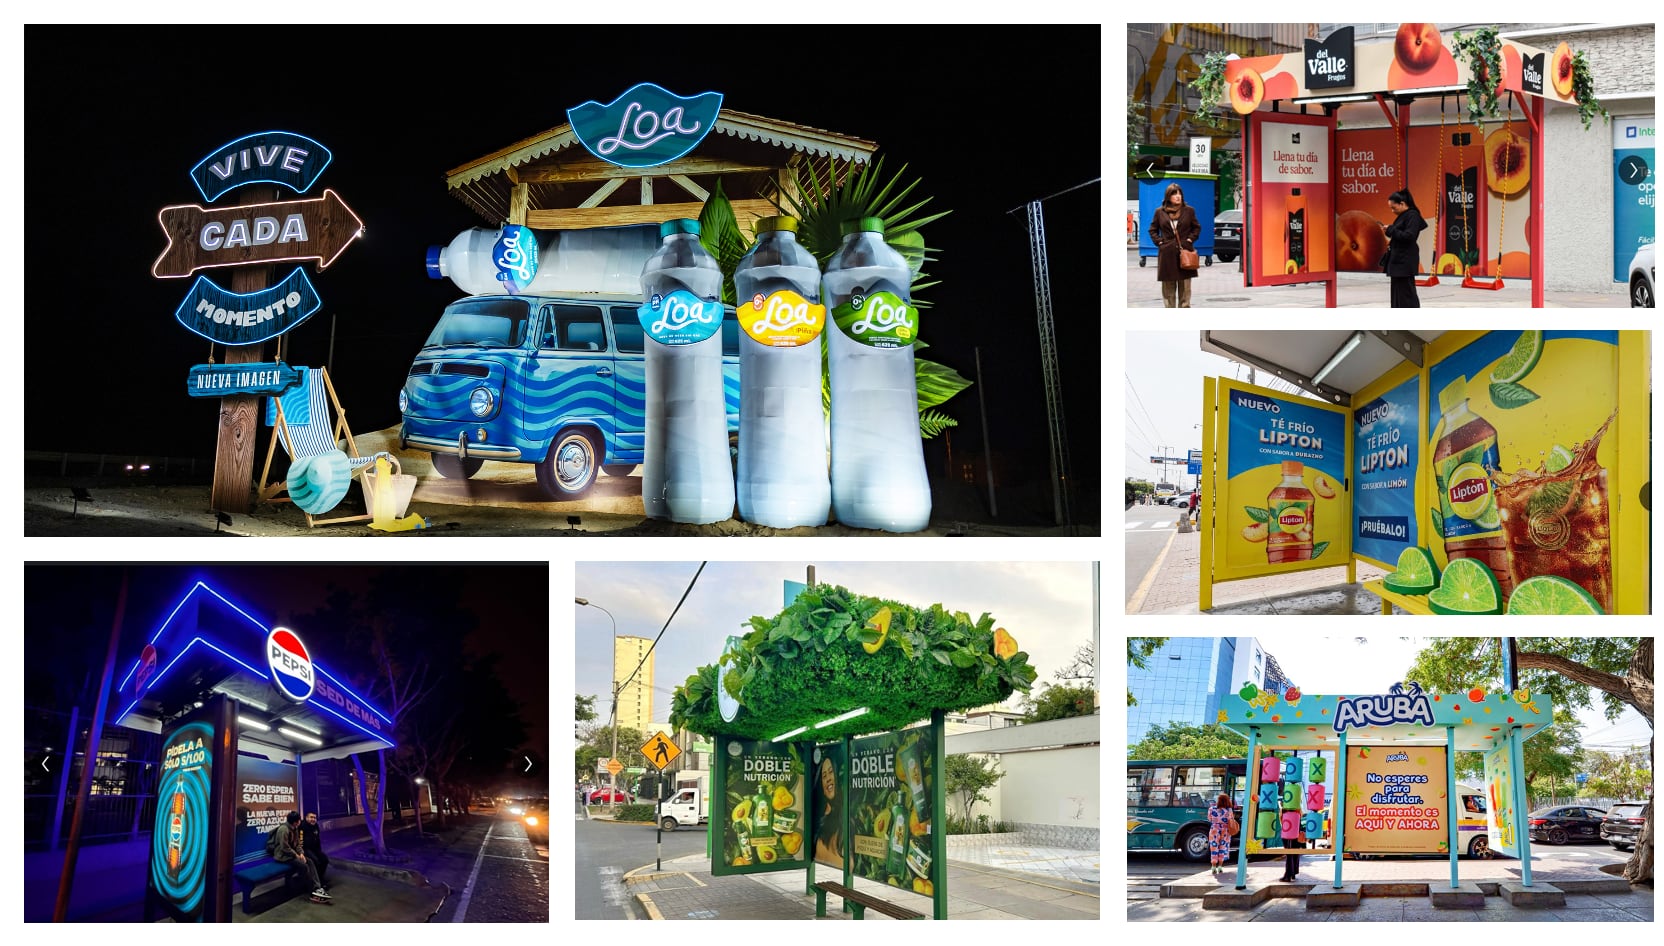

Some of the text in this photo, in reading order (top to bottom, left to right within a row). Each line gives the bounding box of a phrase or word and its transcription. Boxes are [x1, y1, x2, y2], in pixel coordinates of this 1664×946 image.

[1316, 50, 1328, 58] del
[1308, 58, 1346, 75] Valle
[1328, 74, 1346, 82] Frugos
[1523, 69, 1542, 84] Valle
[597, 102, 702, 154] Loa
[1195, 144, 1206, 154] 30
[1273, 150, 1318, 162] Llena tu día
[1342, 148, 1374, 162] Llena
[208, 144, 310, 181] VIVE
[1278, 163, 1314, 175] de sabor.
[1342, 163, 1394, 178] tu día de
[1342, 180, 1379, 194] sabor.
[1638, 183, 1655, 194] op
[200, 214, 308, 250] CADA
[498, 231, 530, 280] Loa
[196, 291, 301, 327] MOMENTO
[652, 296, 712, 333] Loa
[752, 296, 816, 334] Loa
[852, 296, 913, 334] Loa
[197, 370, 281, 389] NUEVA IMAGEN
[1238, 397, 1280, 414] NUEVO
[1361, 403, 1389, 426] NUEVO
[1271, 418, 1315, 434] TÉ FRÍO
[1260, 429, 1322, 449] LIPTON
[1367, 426, 1400, 450] TÉ FRÍO
[1295, 451, 1323, 459] DURAZNO
[1361, 444, 1408, 473] LIPTON
[1388, 477, 1407, 489] LIMÓN
[1452, 480, 1484, 500] Lipton
[1361, 520, 1406, 538] ¡PRUÉBALO!
[272, 644, 311, 681] PEPSI
[316, 680, 344, 707] SED
[346, 698, 360, 719] DE
[1336, 695, 1432, 730] ARUBA
[167, 737, 203, 758] PÍDELA A
[744, 760, 791, 772] DOBLE
[852, 754, 894, 774] DOBLE
[1312, 763, 1323, 775] X
[852, 773, 895, 788] NUTRICIÓN
[1367, 773, 1428, 785] No esperes
[243, 784, 294, 794] ZERO ESPERA
[1385, 785, 1410, 794] para
[243, 794, 294, 803] SABE BIEN
[1262, 790, 1274, 803] X
[1308, 790, 1319, 804] X
[1371, 793, 1424, 804] disfrutar.
[1356, 806, 1366, 816] El
[1369, 806, 1422, 816] momento
[247, 816, 287, 827] ZERO AZÚCA
[1386, 820, 1395, 828] Y
[1398, 820, 1439, 829] AHORA
